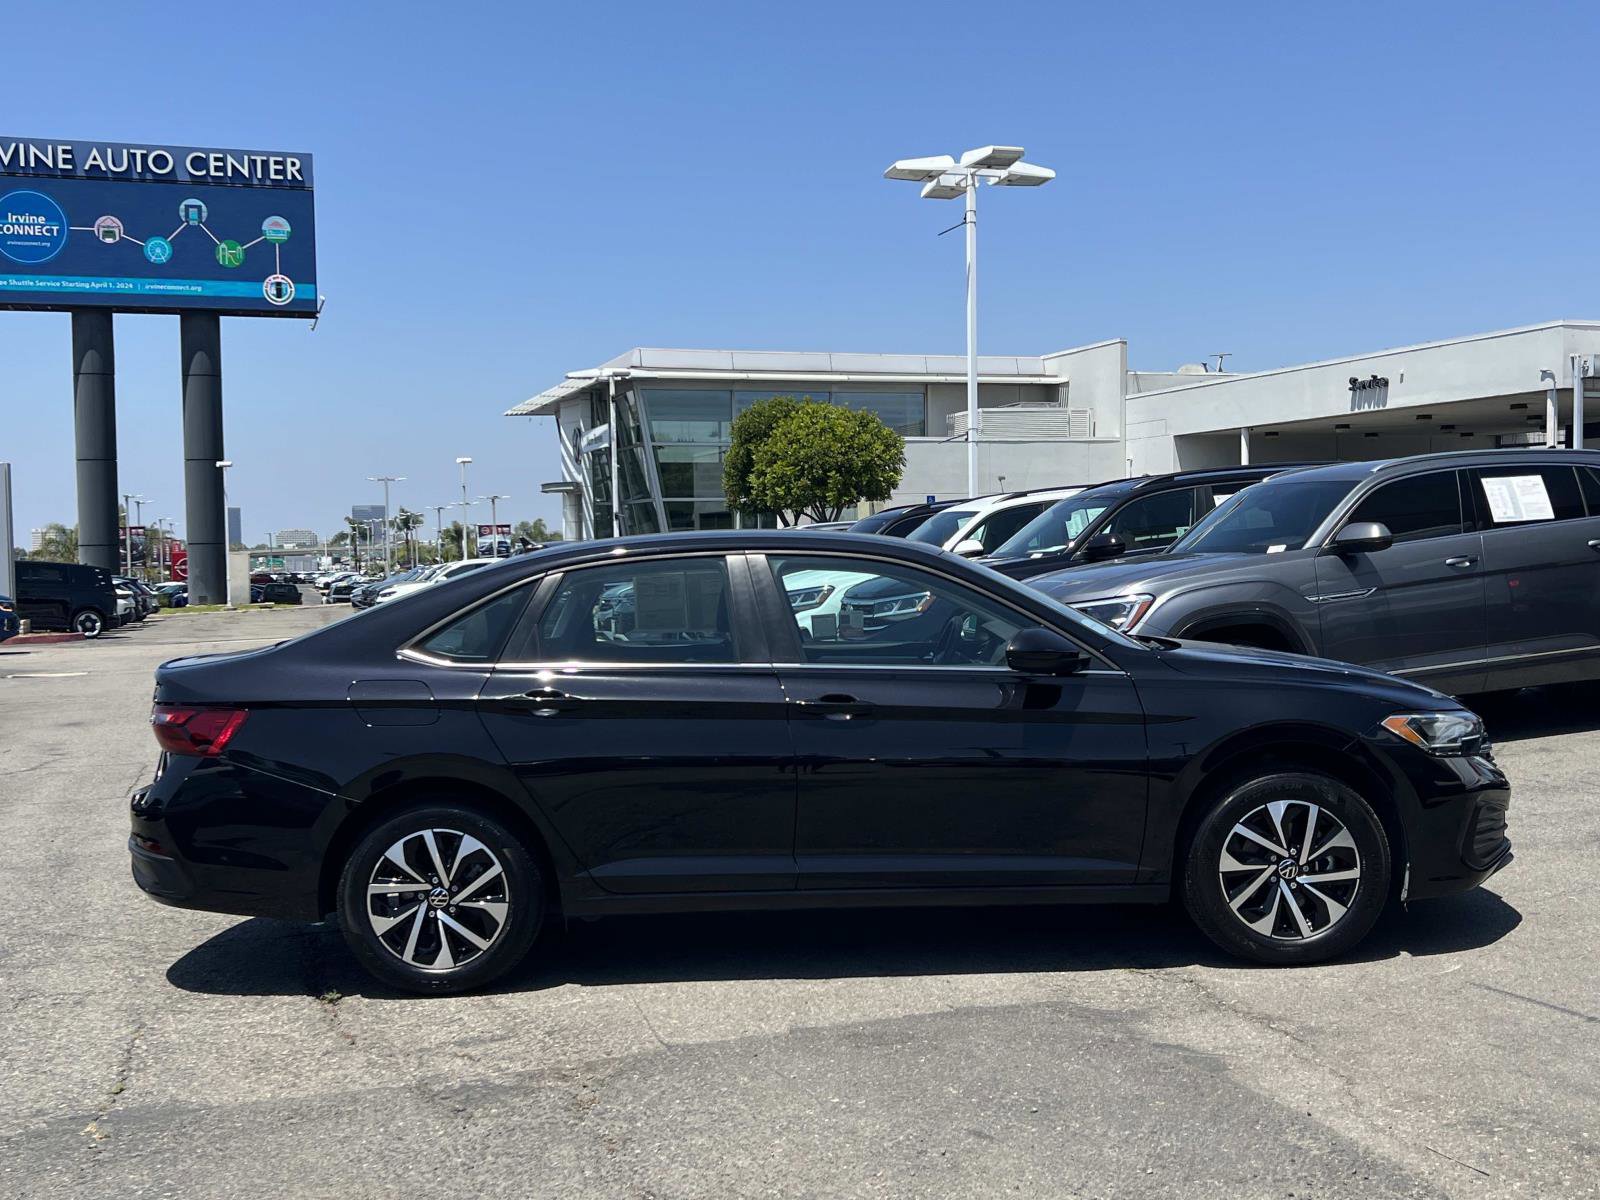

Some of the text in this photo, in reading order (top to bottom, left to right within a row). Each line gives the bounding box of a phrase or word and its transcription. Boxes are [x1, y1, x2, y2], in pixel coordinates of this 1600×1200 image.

[83, 147, 174, 175] AUTO
[185, 152, 304, 181] CENTER
[7, 212, 46, 224] Irvine
[9, 279, 34, 287] Shuttle
[35, 280, 61, 288] Service
[61, 281, 90, 289] Starting
[90, 281, 108, 290] April
